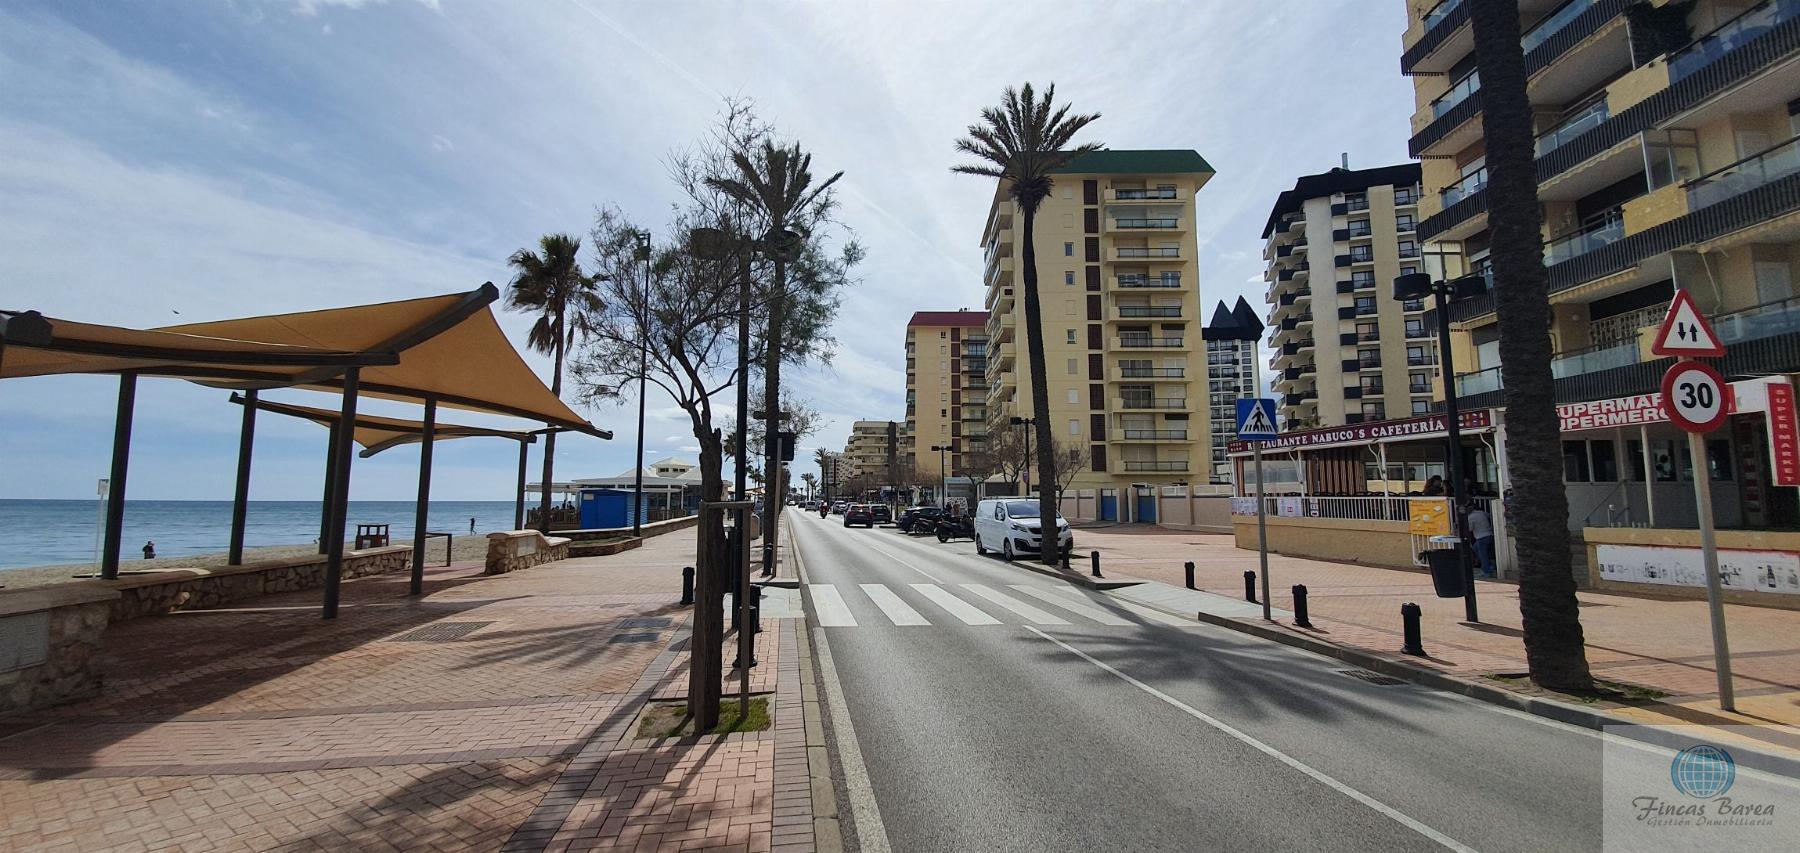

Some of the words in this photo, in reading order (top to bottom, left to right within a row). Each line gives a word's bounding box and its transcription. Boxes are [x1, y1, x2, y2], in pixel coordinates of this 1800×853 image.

[1556, 394, 1664, 419] UPERMAR
[1679, 382, 1713, 409] 30
[1247, 436, 1308, 450] RTAURANTE
[1371, 418, 1445, 437] CAFETERÍA
[1775, 389, 1794, 482] SUPERMARKET
